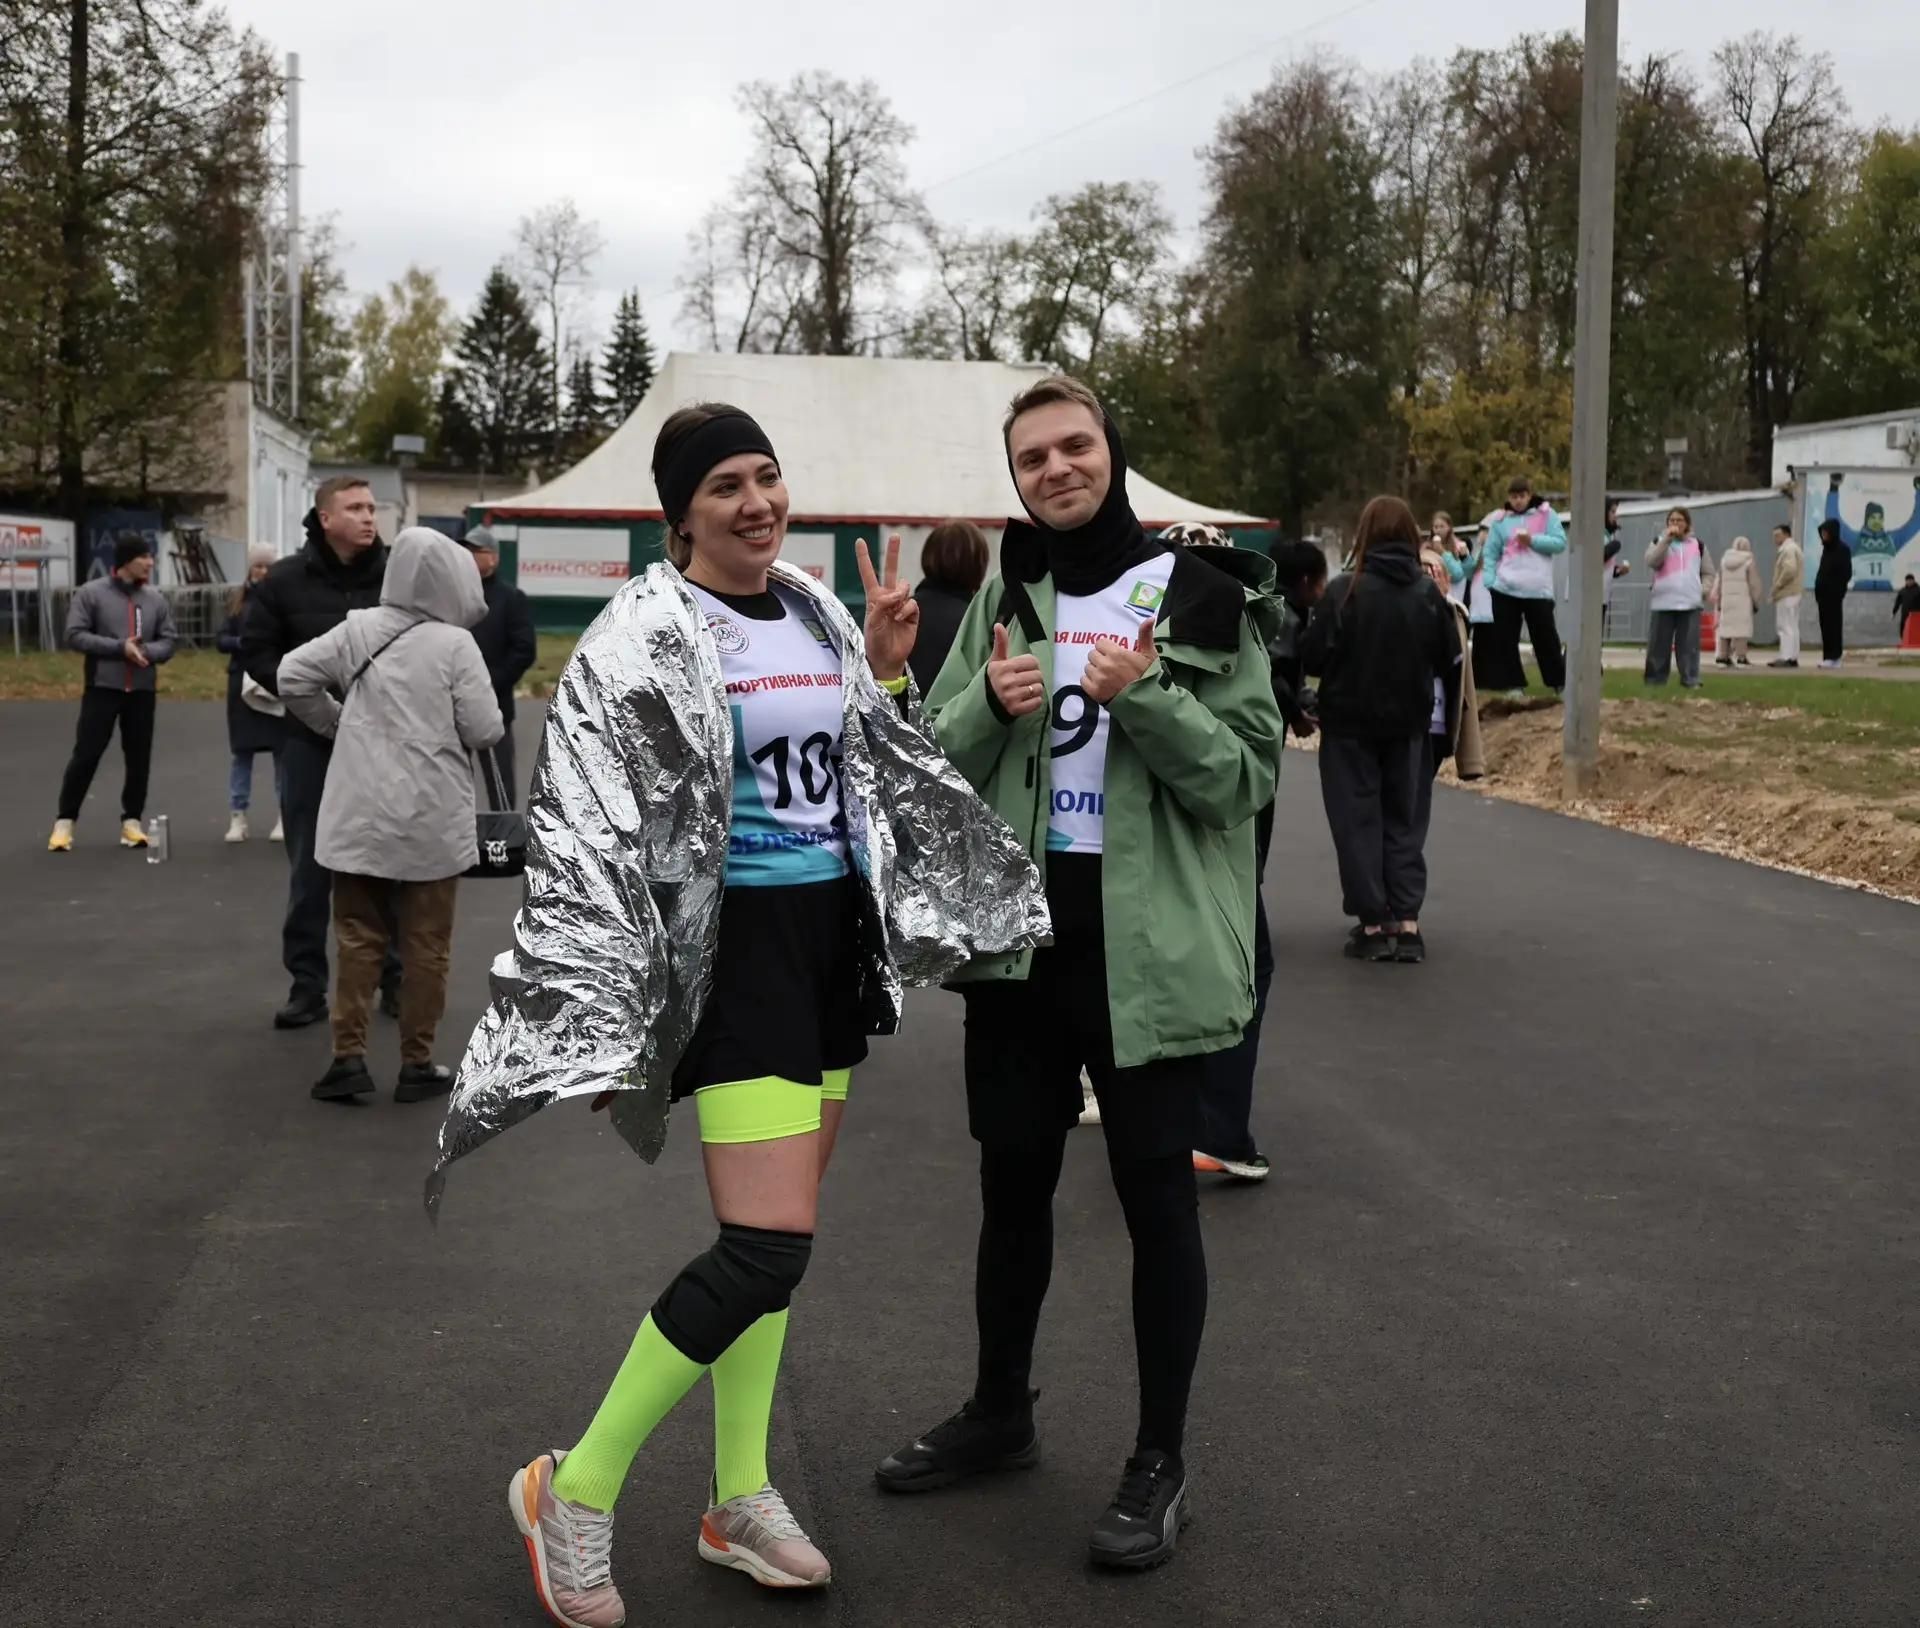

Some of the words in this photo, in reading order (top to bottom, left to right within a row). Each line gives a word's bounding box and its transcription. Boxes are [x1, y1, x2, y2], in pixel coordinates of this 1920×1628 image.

[1869, 561, 1882, 577] 11
[725, 673, 814, 694] ПОРТИВНАЯ
[813, 673, 842, 687] ШКО
[750, 731, 843, 809] 10
